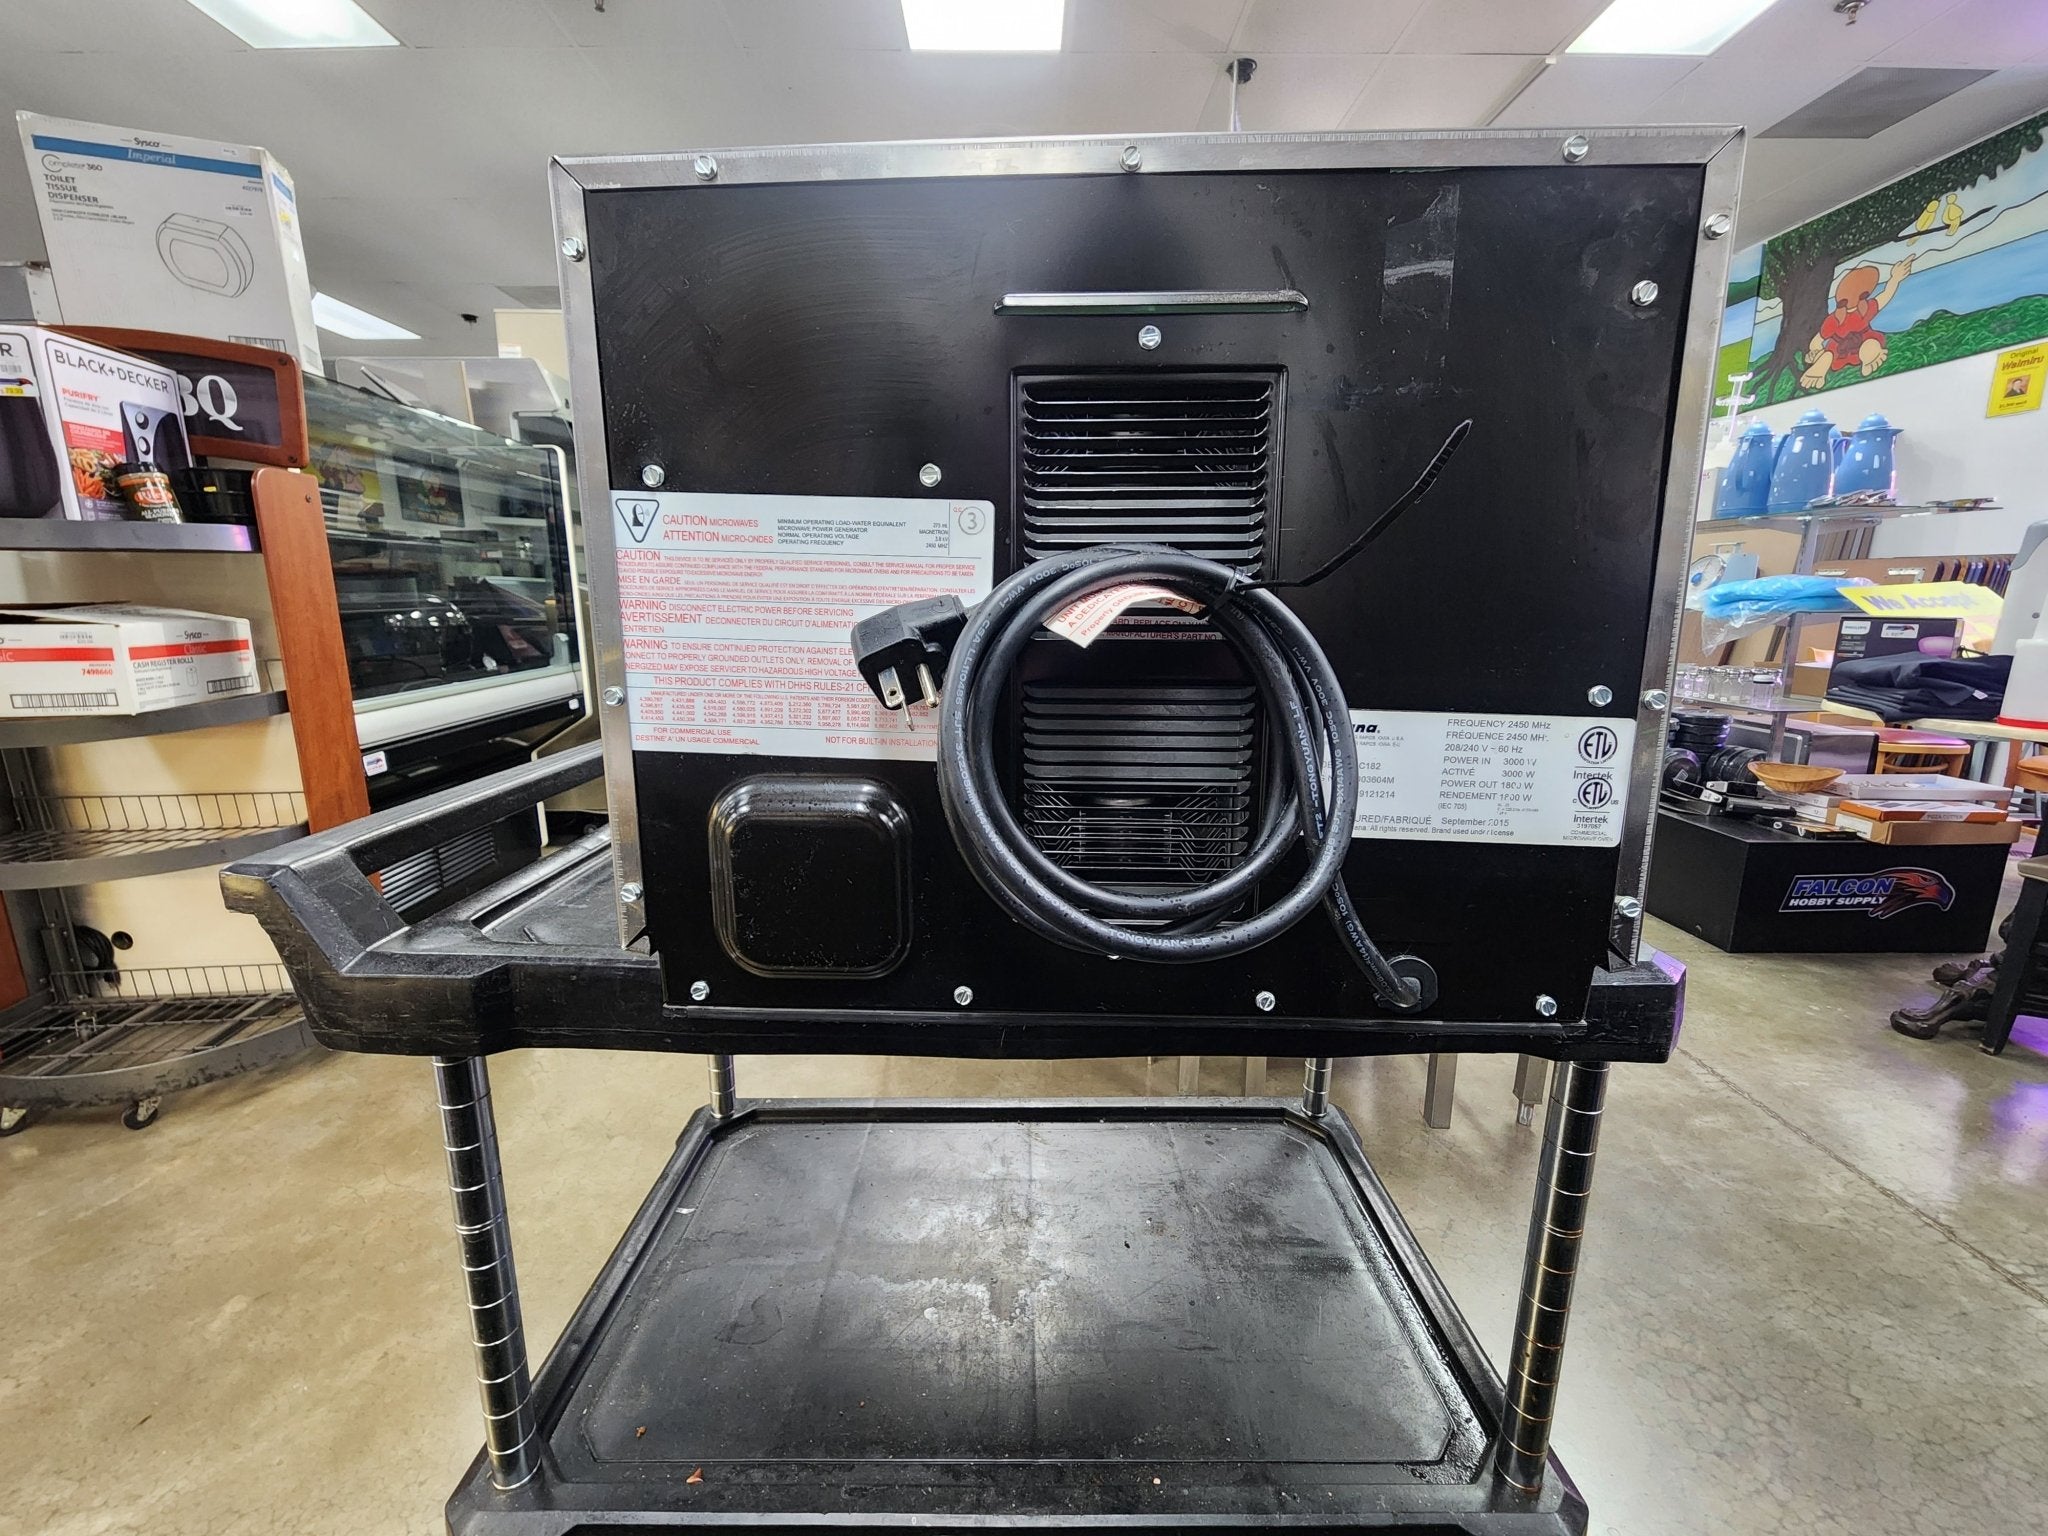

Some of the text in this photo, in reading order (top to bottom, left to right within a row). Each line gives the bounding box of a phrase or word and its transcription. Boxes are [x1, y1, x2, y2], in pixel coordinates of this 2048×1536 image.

[128, 149, 176, 164] Imperial
[44, 174, 76, 183] TOILET
[45, 182, 78, 192] TISSUE
[48, 192, 99, 203] DISPENSER
[54, 349, 170, 394] BLACK+DECKER
[177, 374, 244, 431] BQ
[662, 514, 759, 528] CAUTION MICROWAVES
[968, 512, 977, 530] 3
[663, 530, 774, 544] ATTENTION MICRO-ONDES
[616, 550, 660, 560] CAUTION
[618, 576, 681, 585] MISE EN GARDE
[620, 600, 854, 616] WARNING DISCONNECT ELECTRIC POWER BEFORE SERVICING
[1057, 601, 1080, 623] UNIT
[620, 611, 702, 624] AVERTISSEMENT
[706, 616, 760, 626] DECONNECTER
[774, 619, 802, 627] CIRCUIT
[1080, 608, 1114, 636] Properly
[972, 619, 990, 644] CSA
[671, 642, 680, 650] TO
[714, 644, 756, 652] CONTINUED
[758, 646, 804, 654] PROTECTION
[806, 647, 838, 655] AGAINST
[132, 661, 150, 669] CASH
[150, 659, 177, 668] REGISTER
[668, 652, 706, 660] PROPERLY
[708, 654, 749, 662] GROUNDED
[750, 656, 784, 664] OUTLETS
[808, 658, 841, 666] REMOVAL
[624, 662, 662, 671] NERGIZED
[680, 664, 708, 672] EXPOSE
[710, 665, 748, 673] SERVICER
[748, 666, 758, 674] TO
[759, 667, 803, 676] HAZARDOUS
[805, 668, 822, 676] HIGH
[824, 668, 856, 677] VOLTAGE
[1292, 647, 1312, 673] VW-1
[1312, 678, 1328, 706] 300V
[654, 676, 672, 685] THIS
[675, 676, 716, 687] PRODUCT
[718, 678, 762, 688] COMPLIES
[764, 680, 786, 690] WITH
[788, 681, 812, 690] DHHS
[814, 682, 854, 692] RULES-21
[1290, 701, 1300, 718] LF
[954, 710, 962, 736] SJT
[1448, 719, 1552, 730] FREQUENCY 2450 MHz
[1446, 730, 1504, 740] FRÉQUENCE
[688, 736, 711, 744] USAGE
[712, 738, 760, 746] COMMERCIAL
[826, 736, 938, 746] NOT FOR BUILT-IN INSTALLATION
[1444, 744, 1524, 754] 208/240 V 60 Hz
[1358, 762, 1382, 770] C182
[1444, 756, 1479, 764] POWER
[1504, 758, 1524, 766] 3000
[1442, 767, 1536, 778] ACTIVÉ 3000 W
[1573, 770, 1613, 780] Intertek
[1440, 780, 1476, 788] POWER
[1478, 780, 1498, 788] OUT
[1524, 782, 1534, 790] W
[1440, 791, 1498, 800] RENDEMENT
[1522, 794, 1532, 802] W
[1442, 817, 1486, 826] September
[1488, 818, 1510, 826] 2015
[1574, 814, 1608, 824] Intertek
[1398, 826, 1430, 834] reserved.
[1793, 878, 1896, 896] FALCON
[1788, 896, 1888, 906] HOBBY SUPPLY
